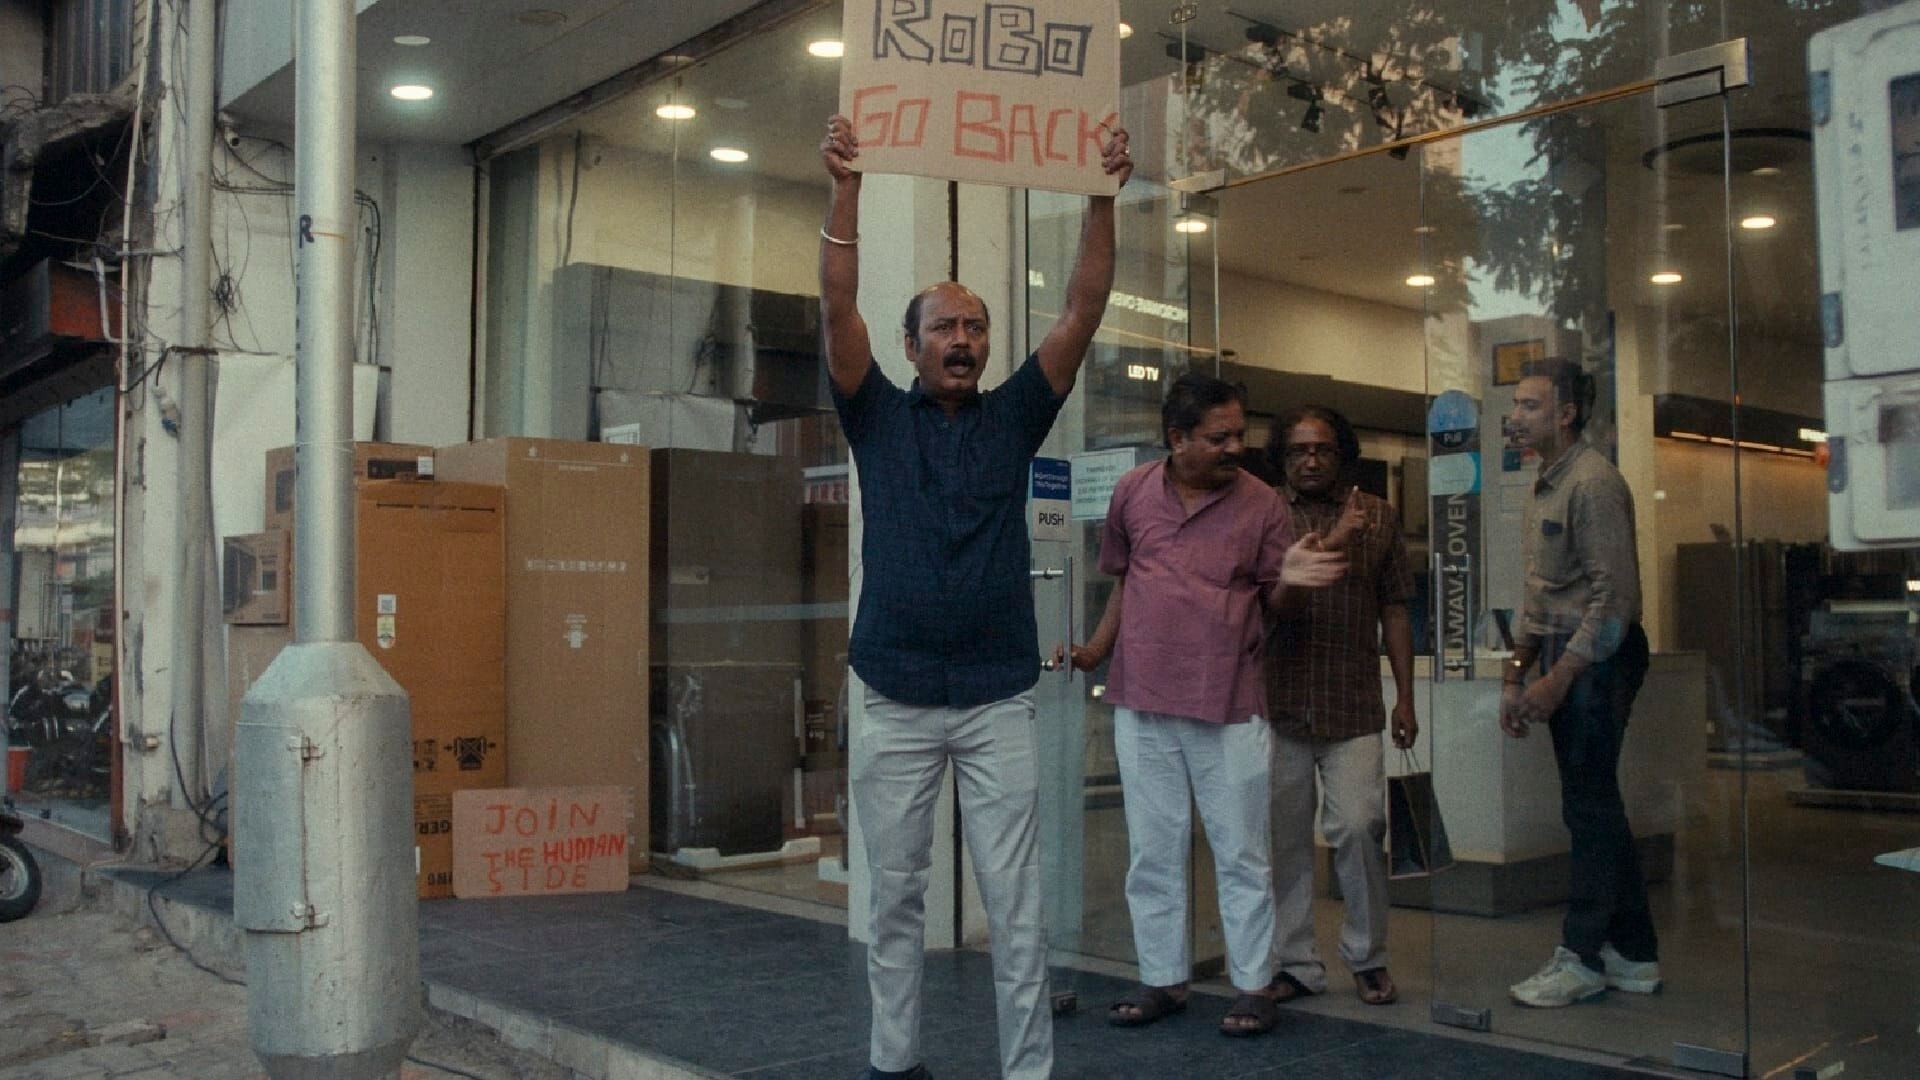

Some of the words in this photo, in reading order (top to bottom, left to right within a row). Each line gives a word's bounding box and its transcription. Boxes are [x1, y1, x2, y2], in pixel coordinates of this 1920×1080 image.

[852, 84, 930, 149] GO
[953, 90, 1119, 167] BACK
[1128, 364, 1145, 379] LED
[1146, 366, 1159, 381] TV
[1039, 512, 1065, 526] PUSH
[485, 798, 600, 836] JOIN
[483, 847, 535, 870] THE
[543, 833, 626, 865] HUMAN
[488, 864, 589, 896] SIDE
